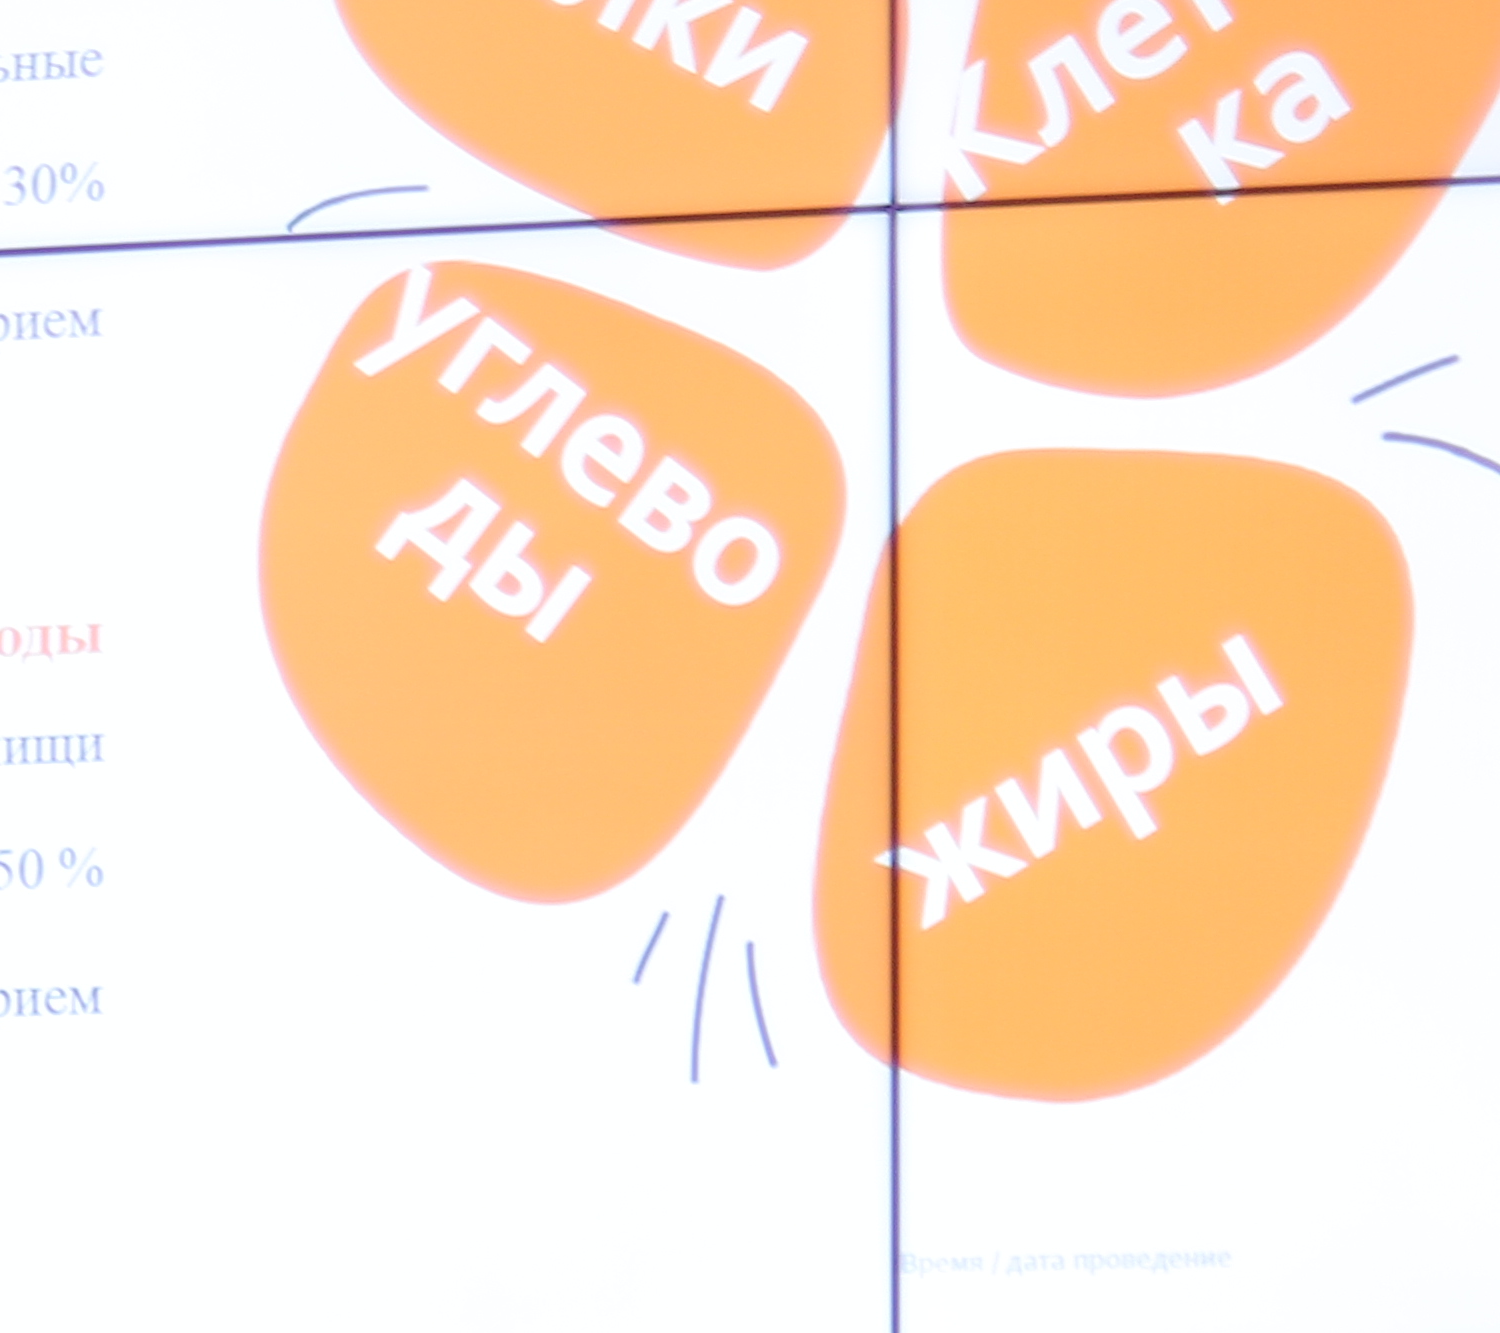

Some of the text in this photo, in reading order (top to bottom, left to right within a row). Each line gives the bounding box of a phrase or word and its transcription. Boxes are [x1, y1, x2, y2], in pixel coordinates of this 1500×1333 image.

[4, 161, 106, 206] 30%
[1177, 48, 1352, 206] ка
[352, 262, 782, 607] углево
[375, 477, 593, 643] ды
[873, 632, 1285, 931] жиры
[58, 847, 105, 888] %
